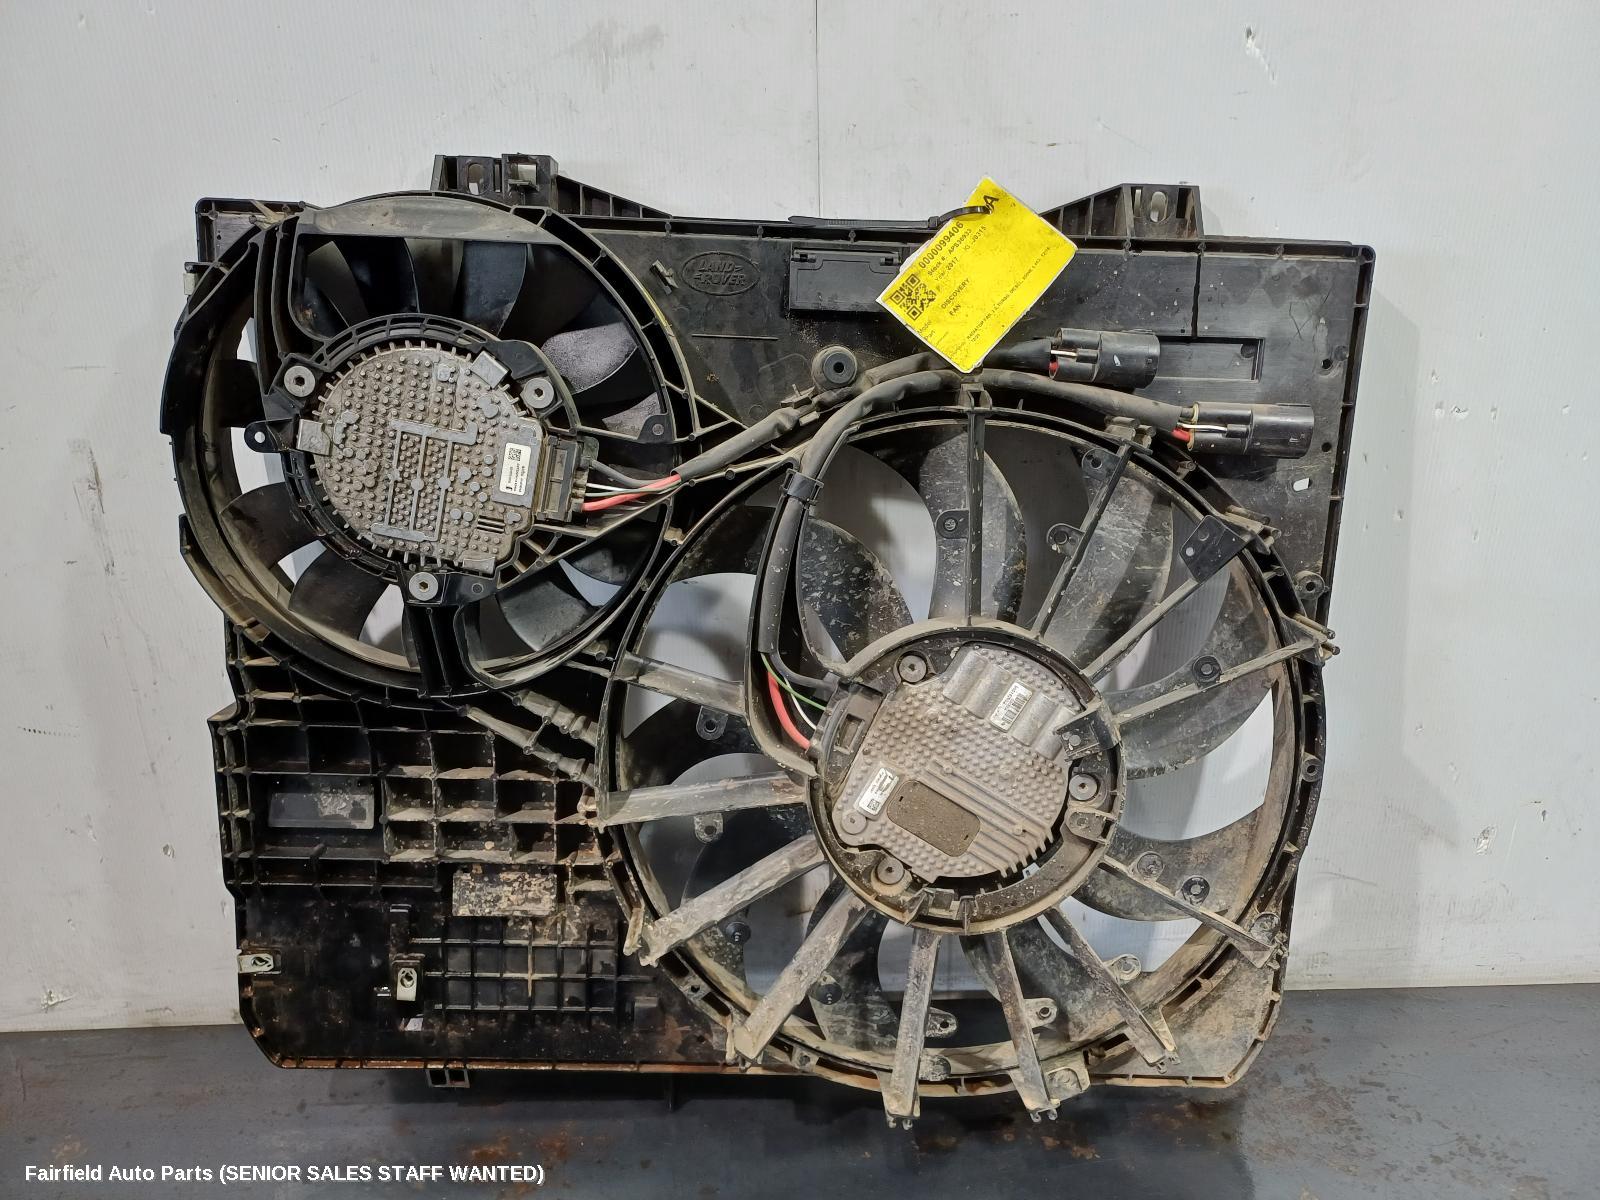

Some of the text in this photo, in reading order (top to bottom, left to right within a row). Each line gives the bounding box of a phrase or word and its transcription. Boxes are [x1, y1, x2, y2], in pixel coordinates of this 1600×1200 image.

[983, 194, 1000, 211] A
[917, 219, 964, 270] 0000099406
[698, 260, 736, 273] LAND
[945, 256, 959, 270] 2017
[700, 273, 746, 286] ROVER
[940, 277, 970, 309] DISCOVERY
[948, 302, 961, 316] FAN
